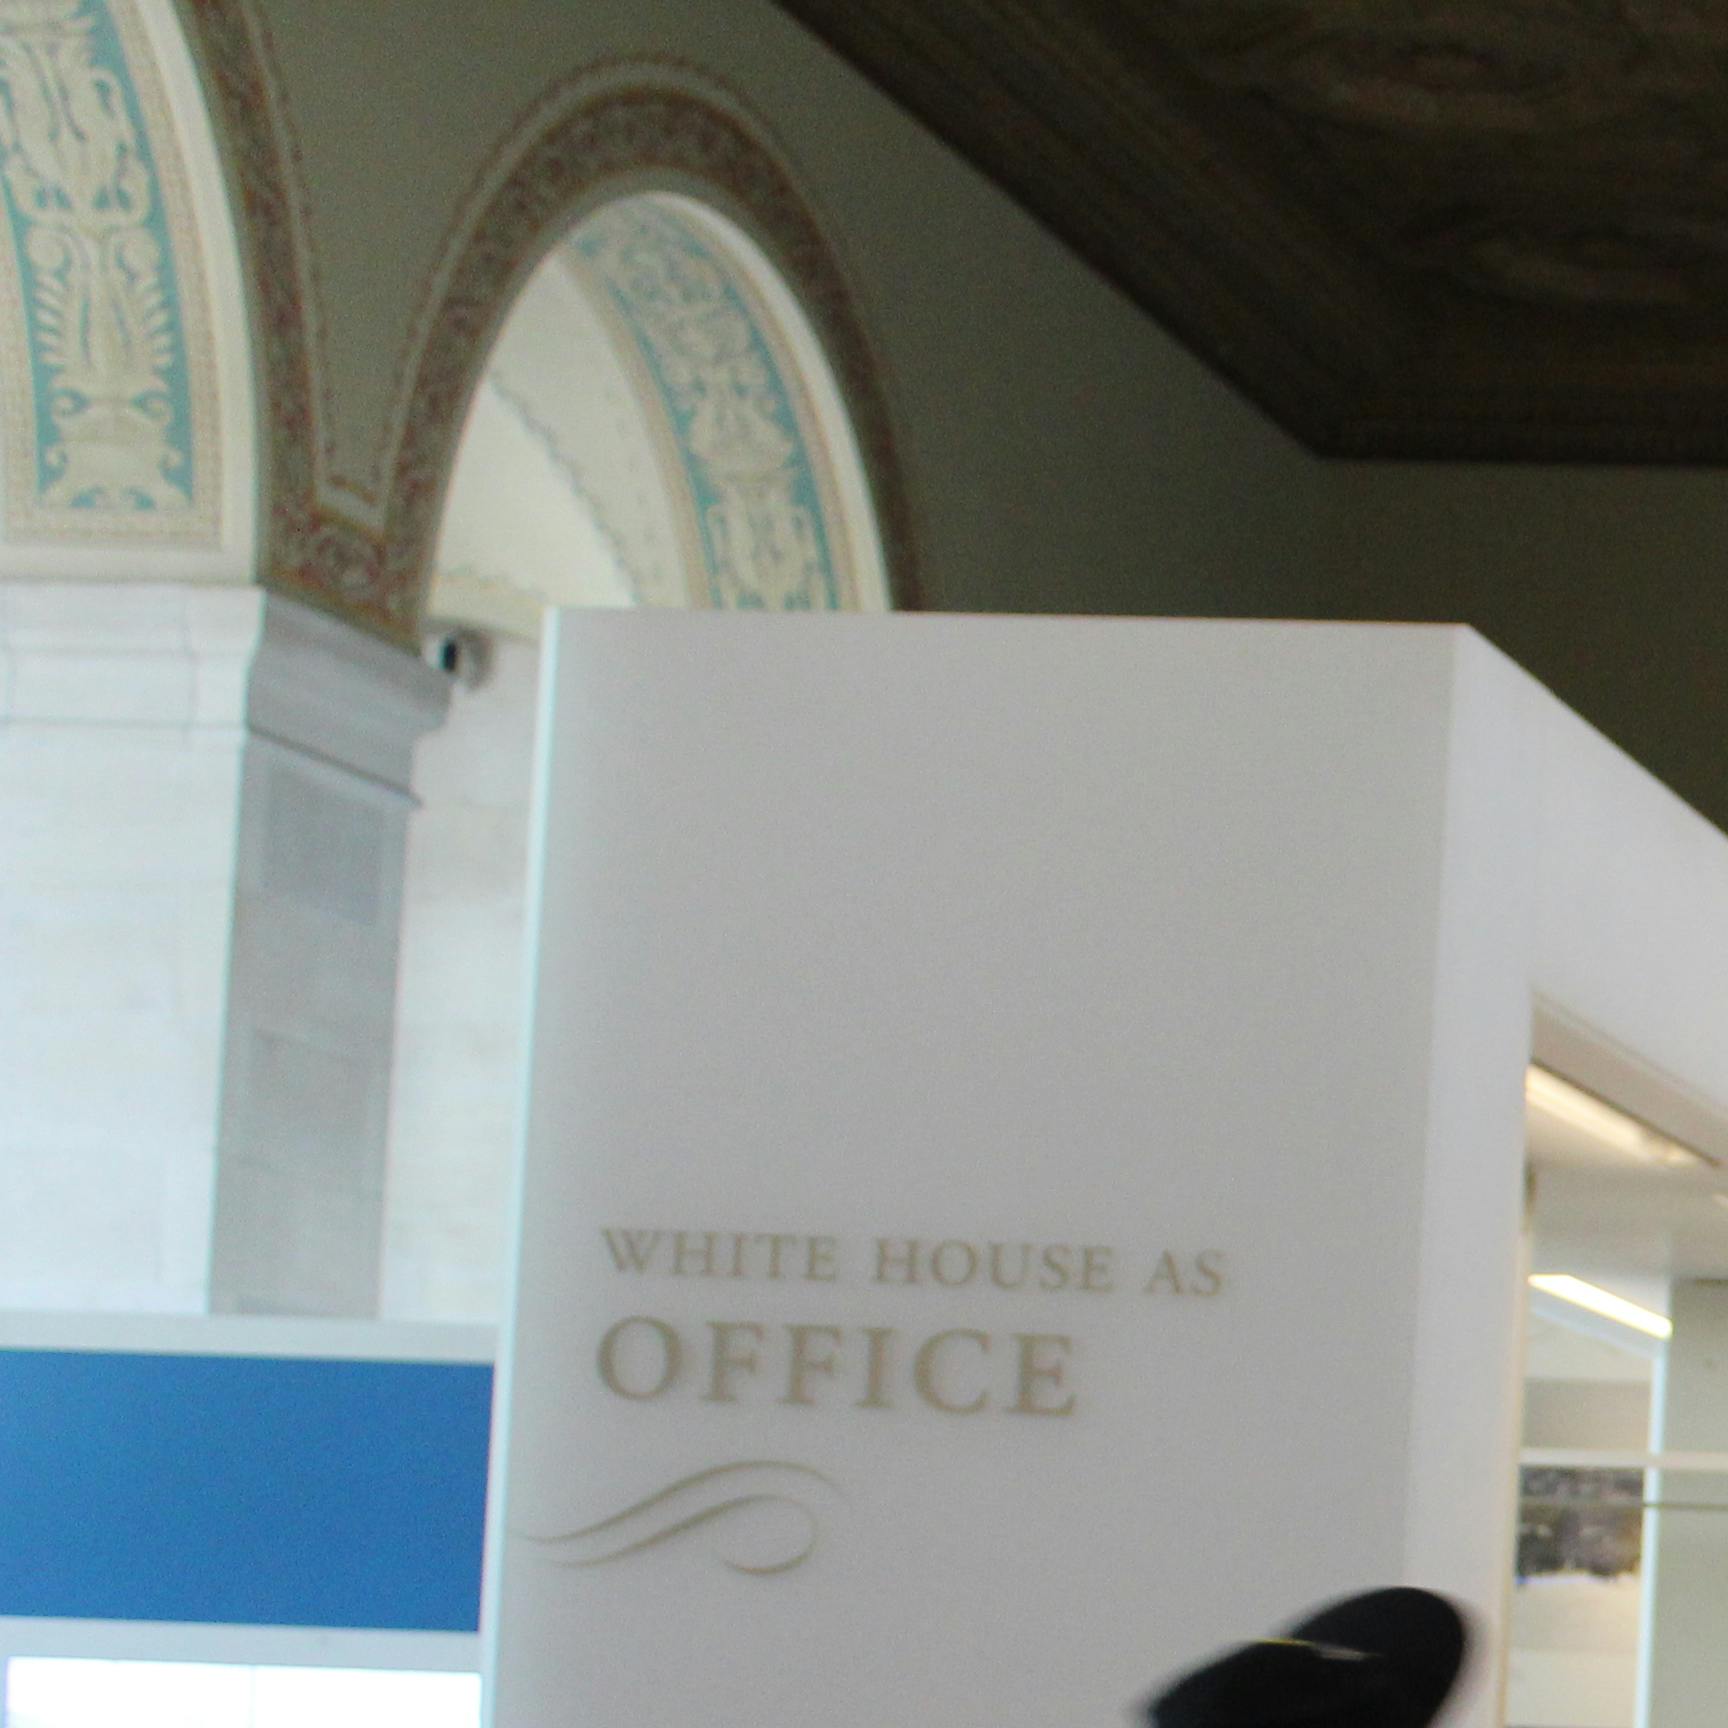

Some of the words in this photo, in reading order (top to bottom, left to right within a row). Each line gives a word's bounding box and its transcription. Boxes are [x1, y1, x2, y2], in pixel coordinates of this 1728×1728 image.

[602, 1229, 838, 1282] WHITE
[873, 1237, 1114, 1294] HOUSE
[1142, 1249, 1228, 1297] AS
[597, 1314, 1078, 1417] OFFICE
